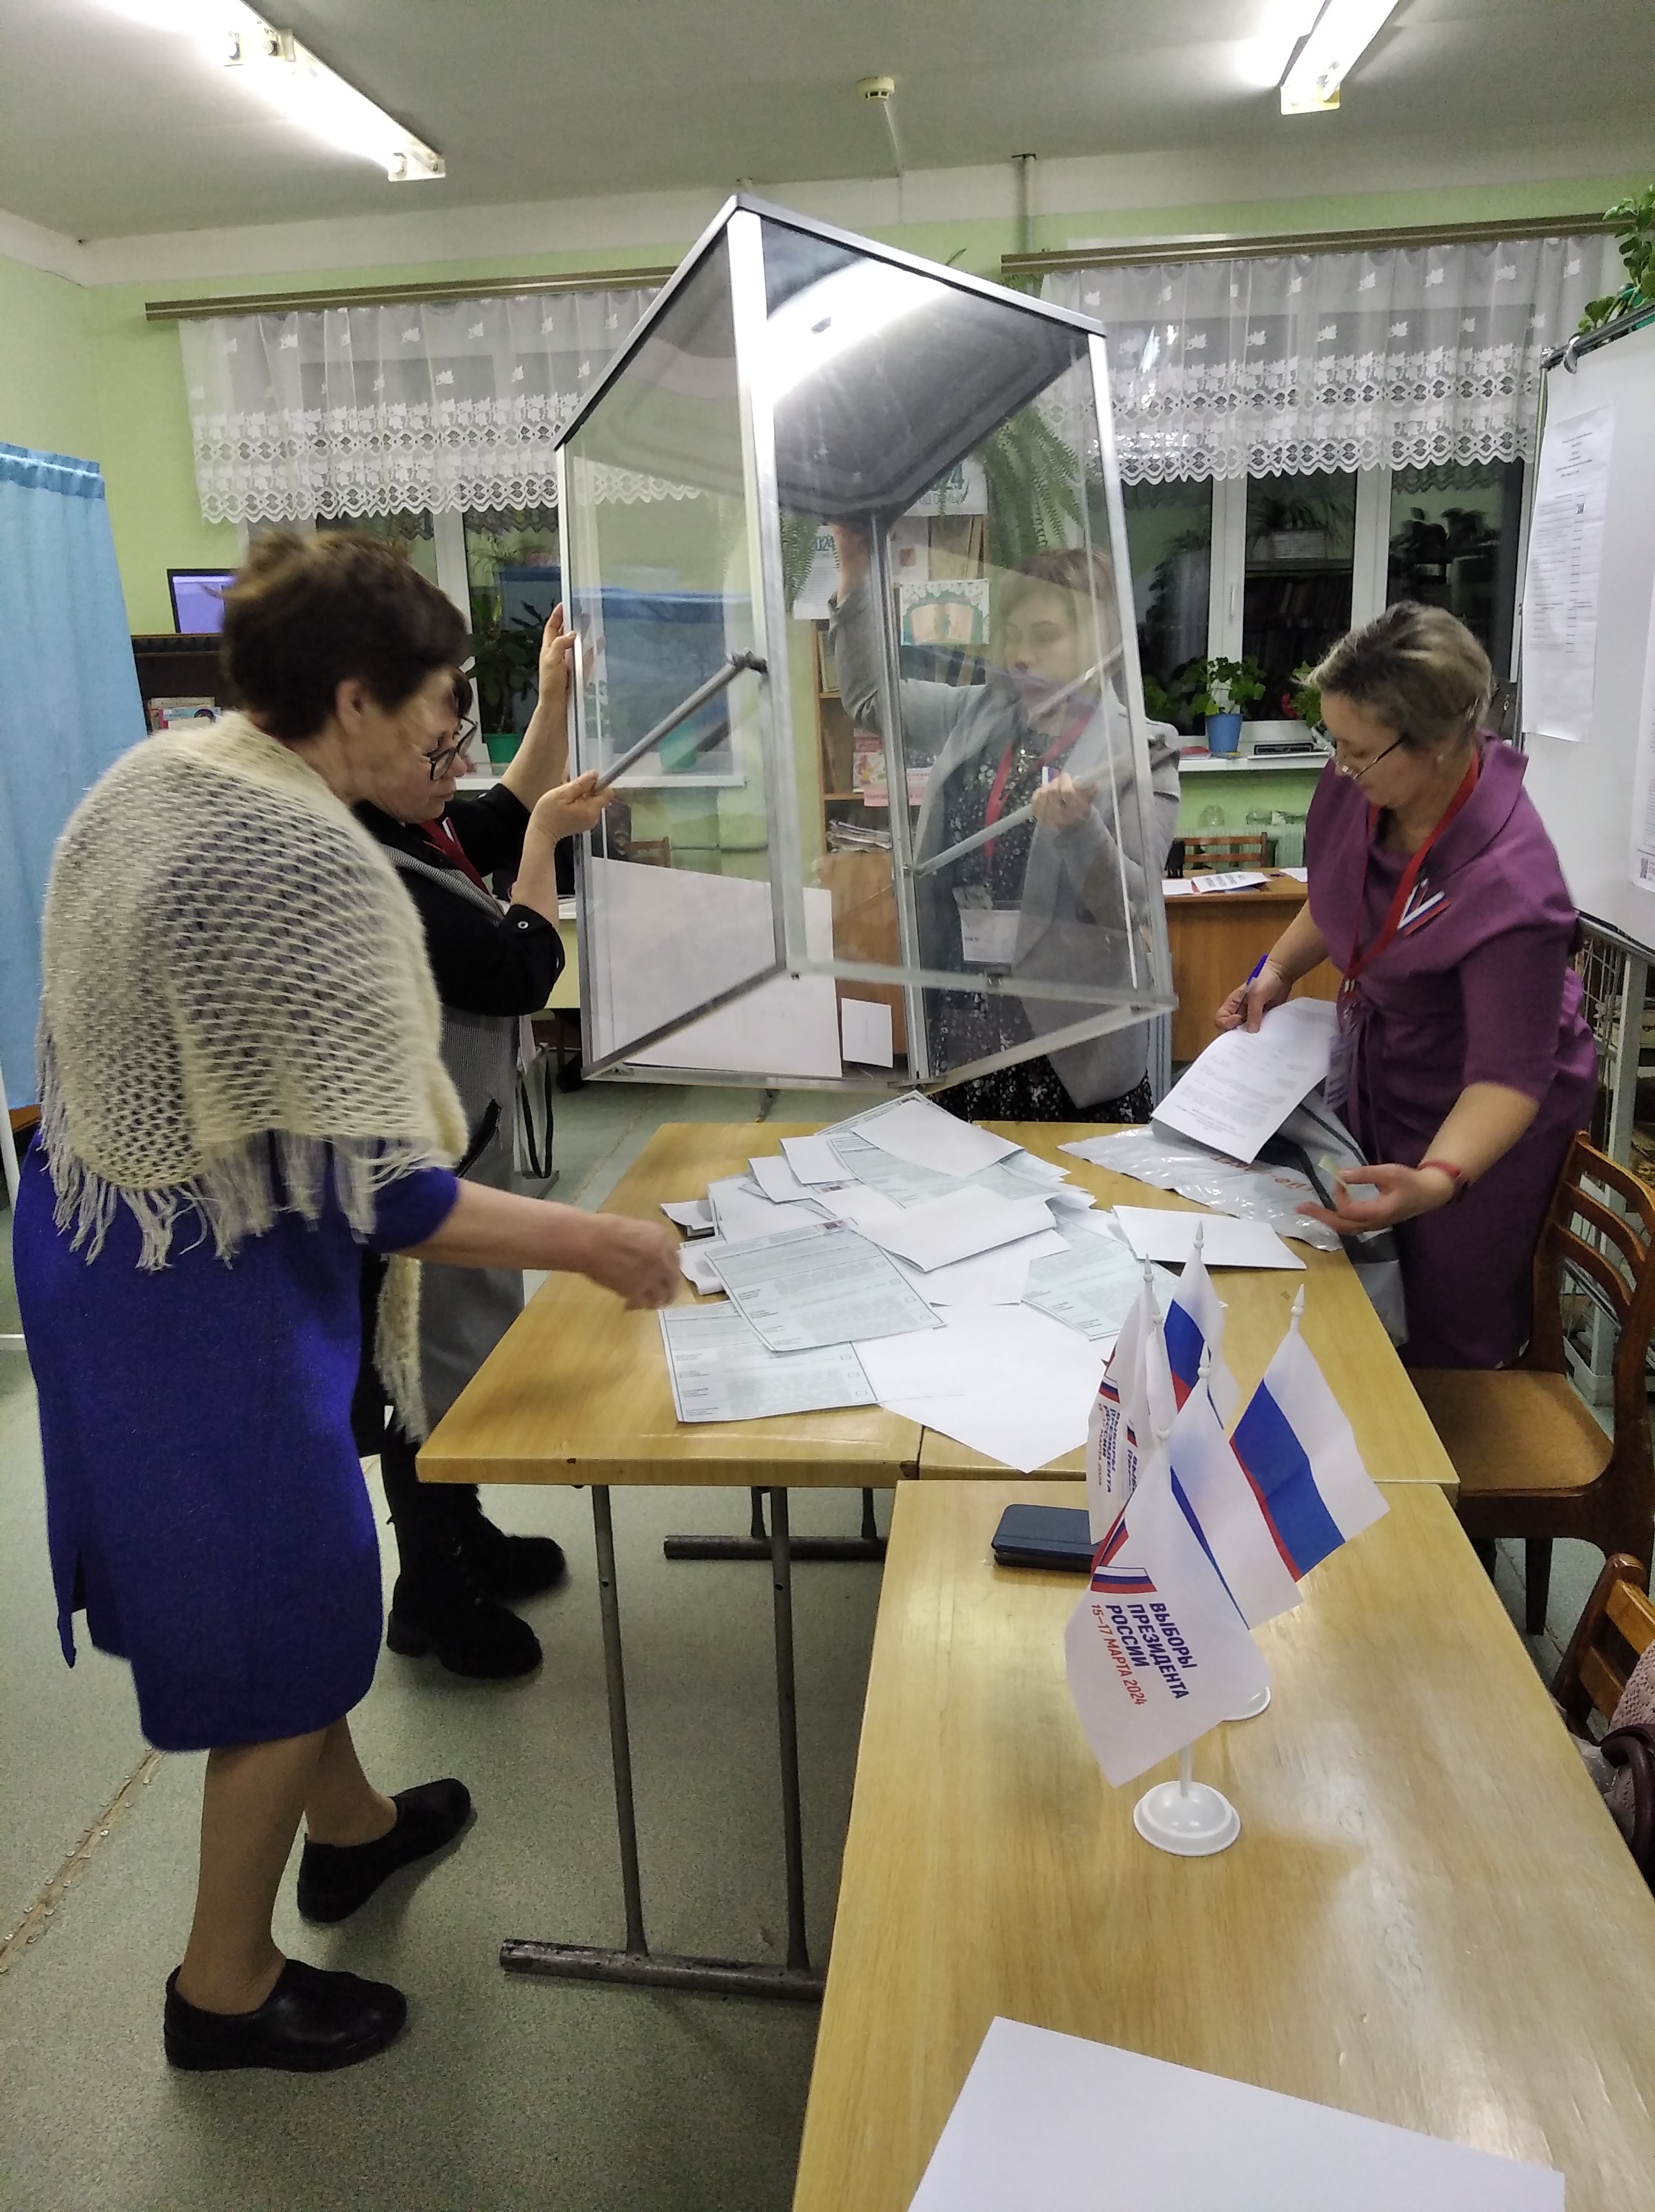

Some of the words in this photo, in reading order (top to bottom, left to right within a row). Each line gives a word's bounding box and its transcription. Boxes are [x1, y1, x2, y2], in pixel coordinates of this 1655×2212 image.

[1103, 1404, 1111, 1457] РОССИИ
[1107, 1408, 1117, 1493] ПРЕЗИДЕНТА
[1112, 1412, 1121, 1472] ВЫБОРЫ
[1105, 1605, 1150, 1667] РОССИИ
[1127, 1604, 1190, 1699] ПРЕЗИДЕНТА
[1149, 1603, 1197, 1669] ВЫБОРЫ
[1104, 1638, 1133, 1677] МАРТА
[1123, 1679, 1147, 1706] 2024
